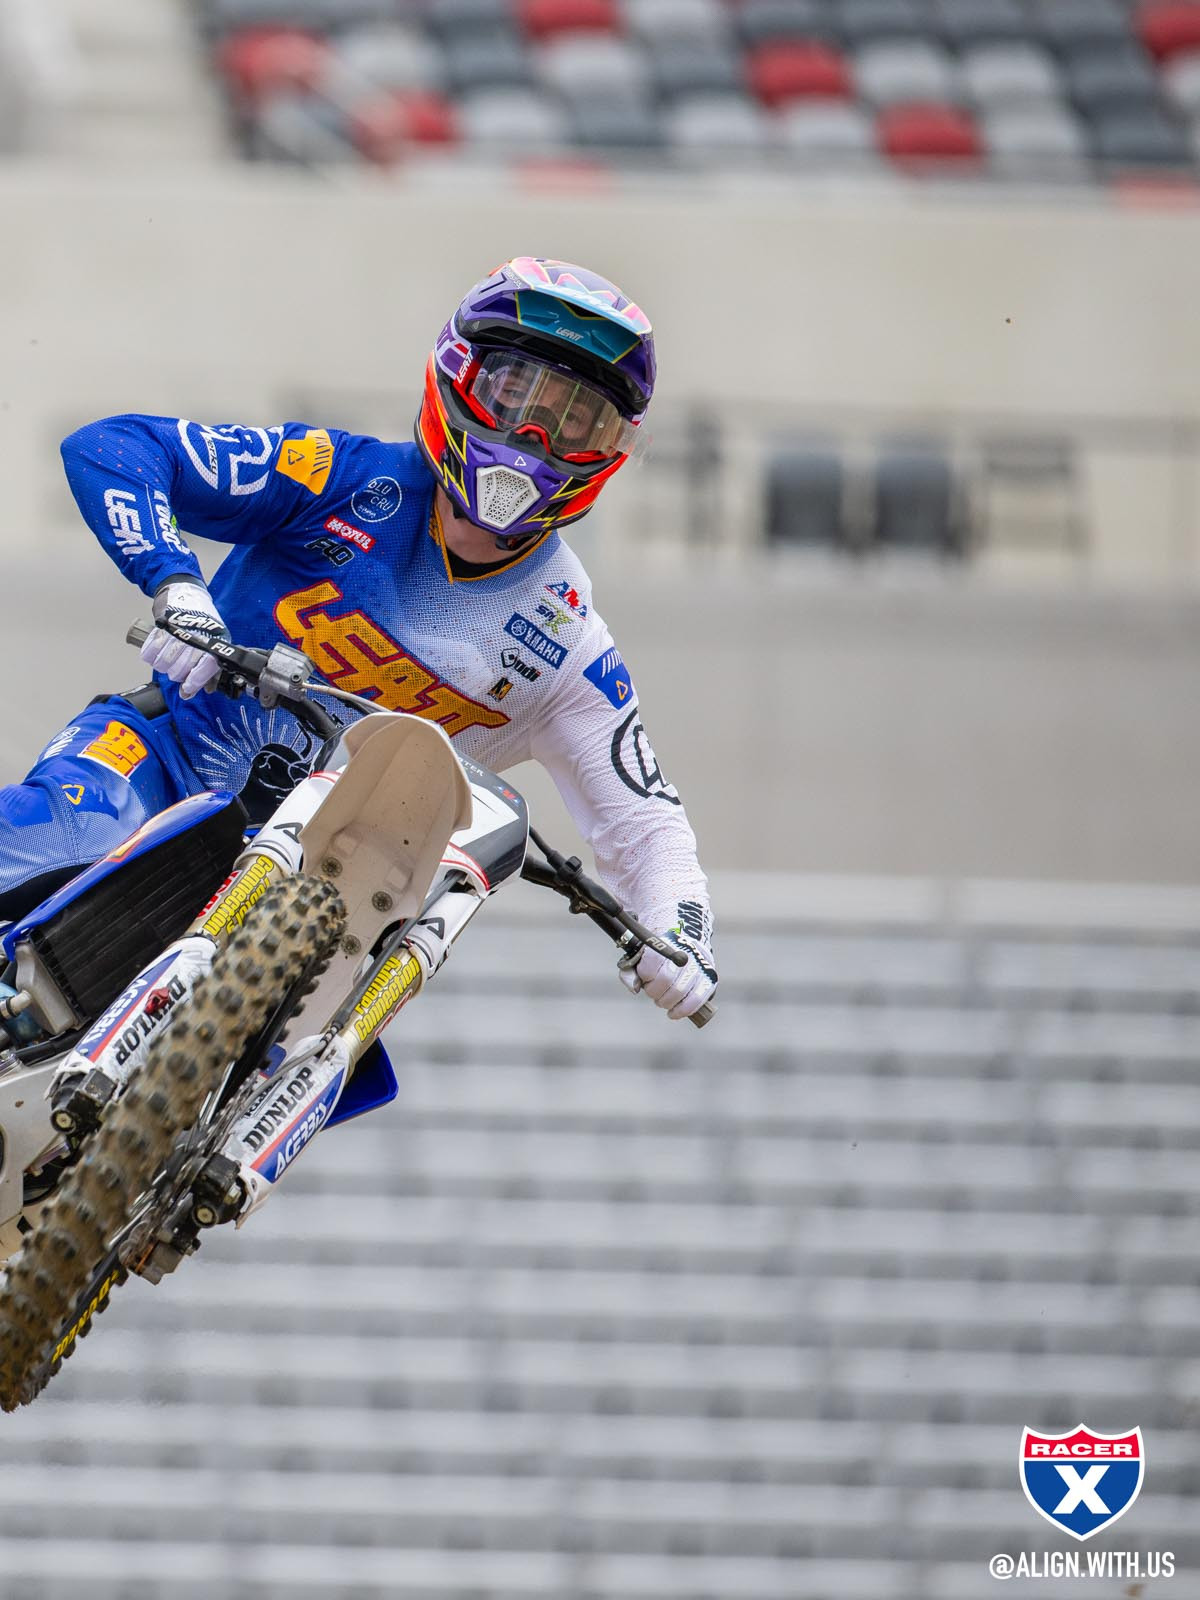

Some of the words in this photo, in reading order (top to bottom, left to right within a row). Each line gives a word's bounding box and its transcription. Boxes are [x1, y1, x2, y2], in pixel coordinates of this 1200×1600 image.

[555, 327, 584, 341] LEATT
[370, 496, 394, 511] CRU
[326, 518, 373, 550] MOTUL
[303, 537, 355, 567] FLO
[544, 580, 588, 620] AMA
[167, 612, 225, 631] LEATT
[173, 629, 192, 641] FLO
[210, 642, 236, 657] FLO
[524, 626, 563, 665] YAMAHA
[202, 855, 275, 937] Connection
[645, 936, 667, 951] FLO
[355, 957, 421, 1042] Connection
[243, 1067, 313, 1152] DUNLOP
[274, 1102, 328, 1185] ACERBIS
